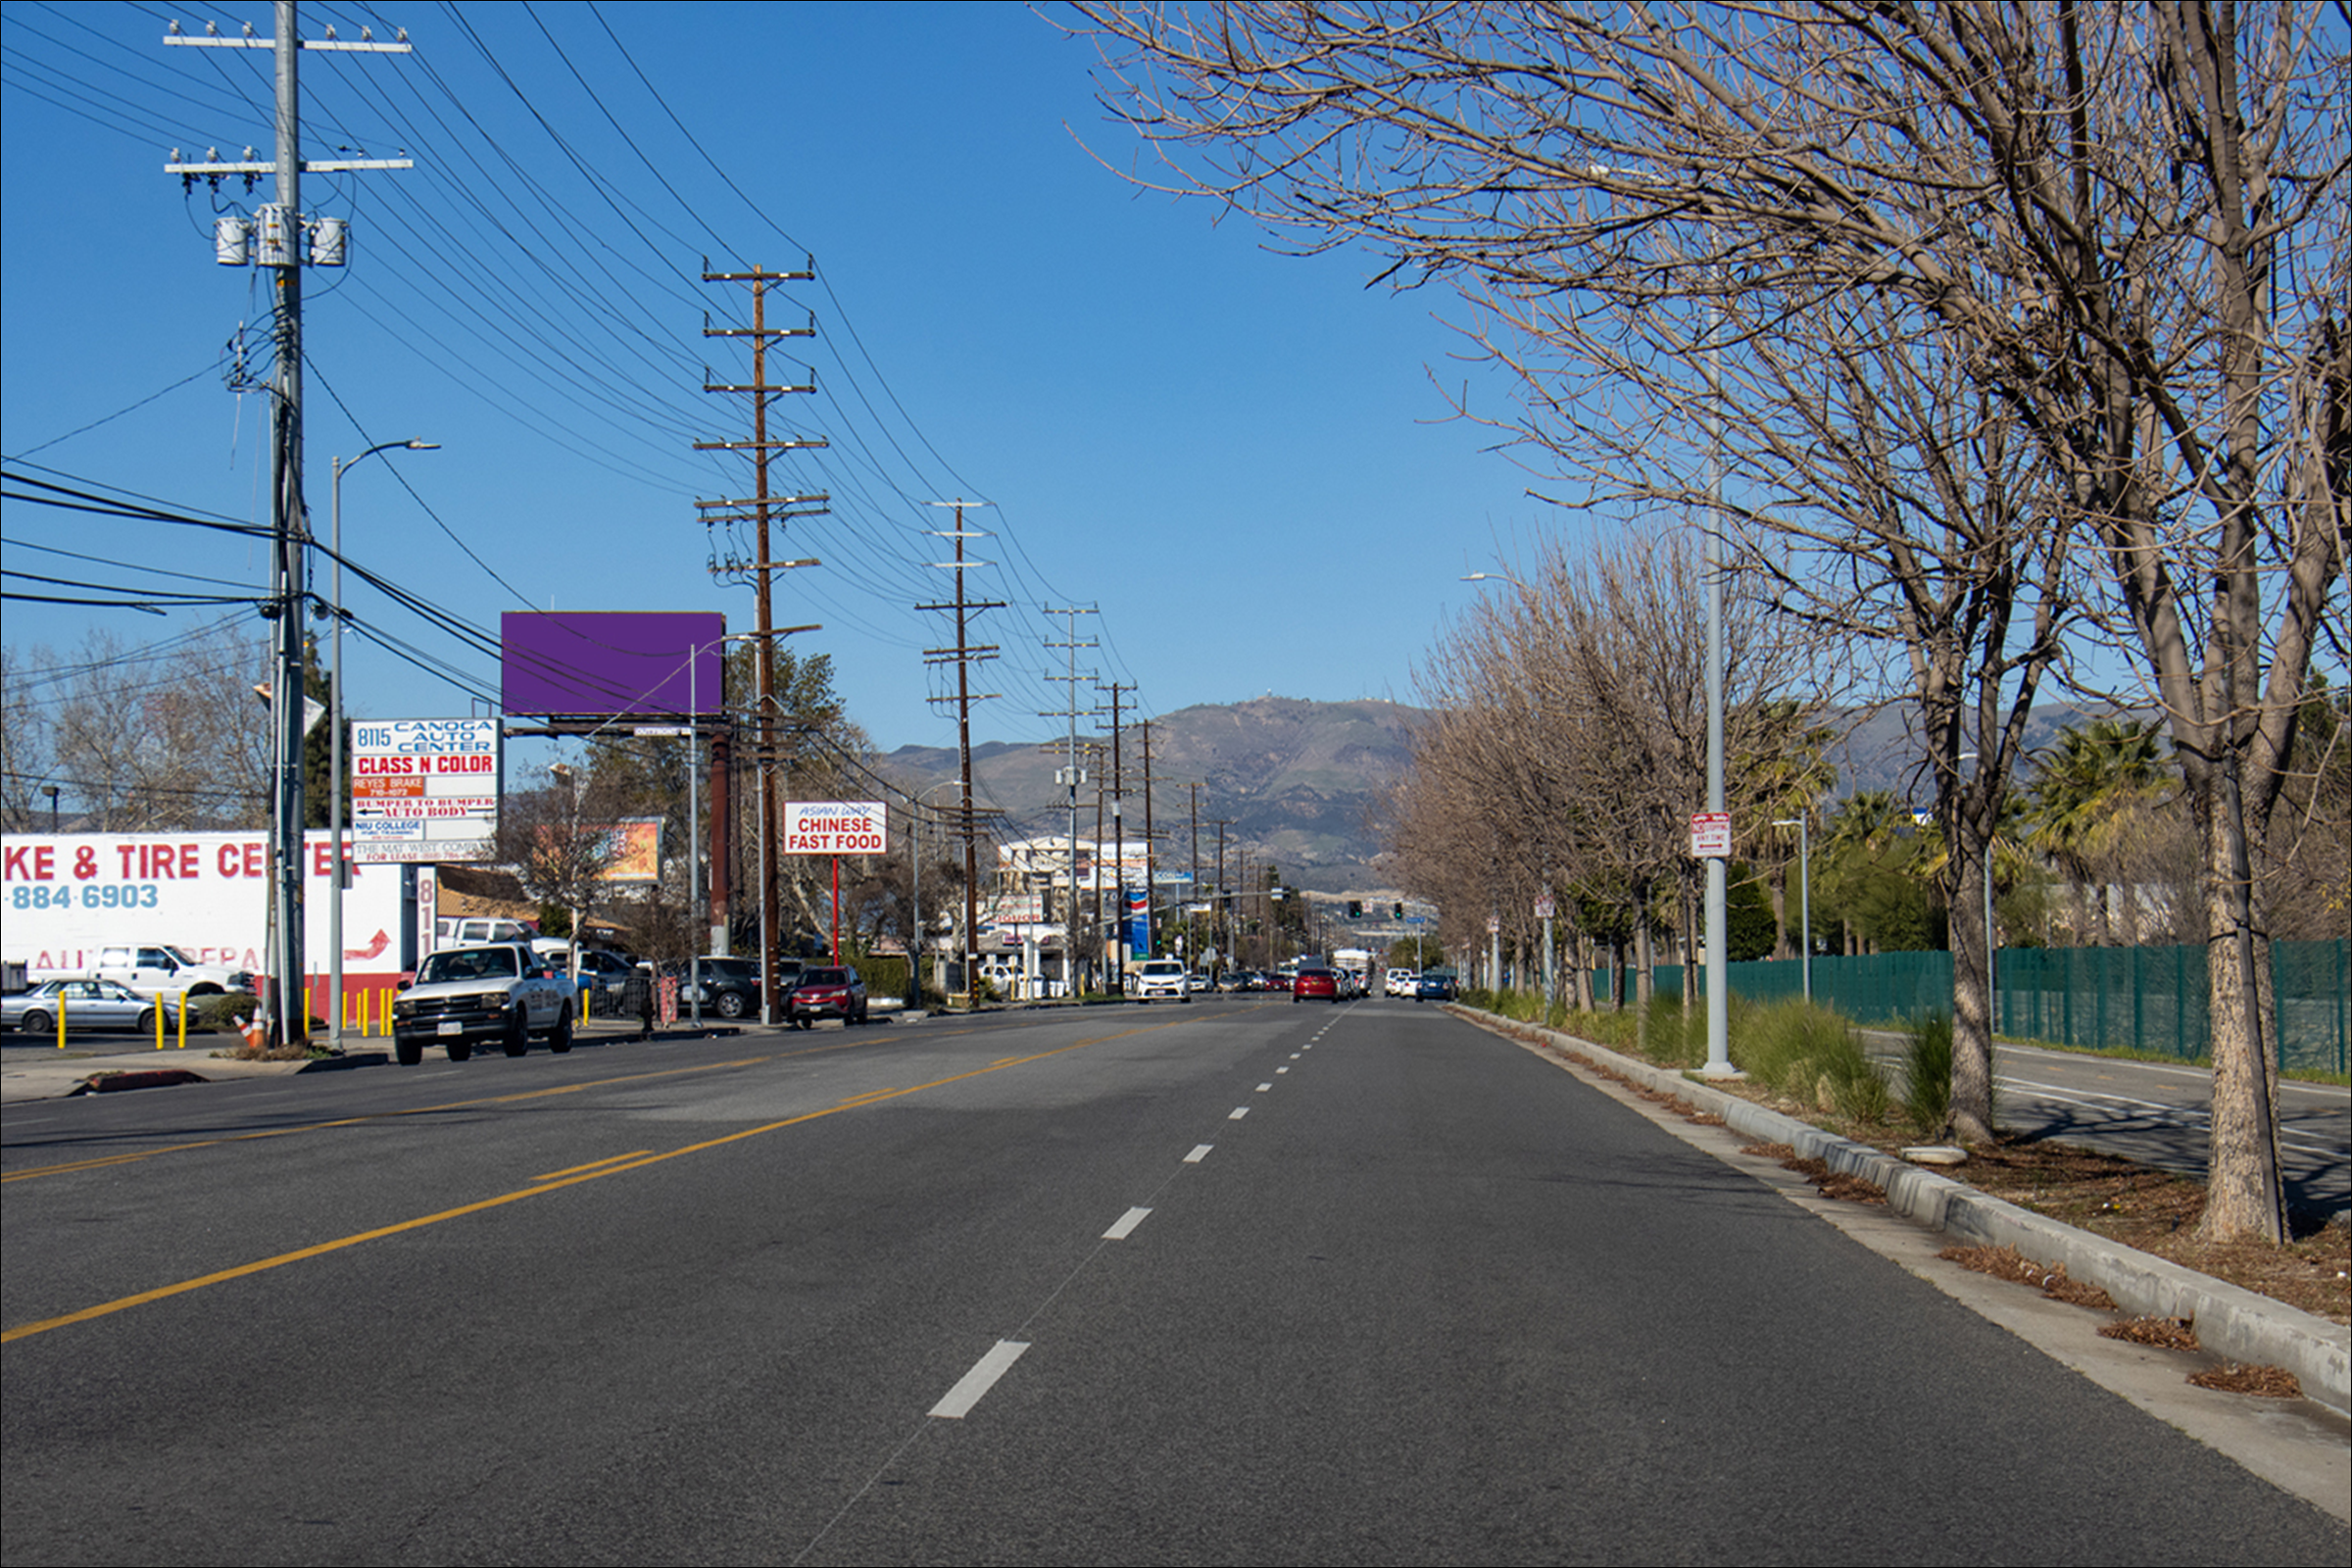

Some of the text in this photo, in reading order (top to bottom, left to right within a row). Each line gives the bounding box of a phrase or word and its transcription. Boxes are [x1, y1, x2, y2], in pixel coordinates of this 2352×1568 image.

[394, 721, 493, 732] CANOGA
[358, 728, 390, 747] 8115
[413, 732, 475, 742] AUTO
[398, 742, 490, 753] CENTER
[358, 756, 492, 774] CLASS N COLOR
[354, 777, 421, 789] REYES BRAKE
[438, 798, 494, 807] BUMPER
[382, 807, 467, 817] AUTO BODY
[799, 806, 839, 816] ASIAN
[375, 821, 420, 830] COLLEGE
[798, 817, 872, 832] CHINESE
[1693, 822, 1704, 833] NO
[789, 834, 882, 850] FAST FOOD
[357, 845, 377, 854] THE
[409, 843, 437, 853] WEST
[74, 845, 98, 881] &
[117, 844, 200, 880] TIRE
[218, 842, 362, 879] CEE
[419, 879, 434, 964] 811
